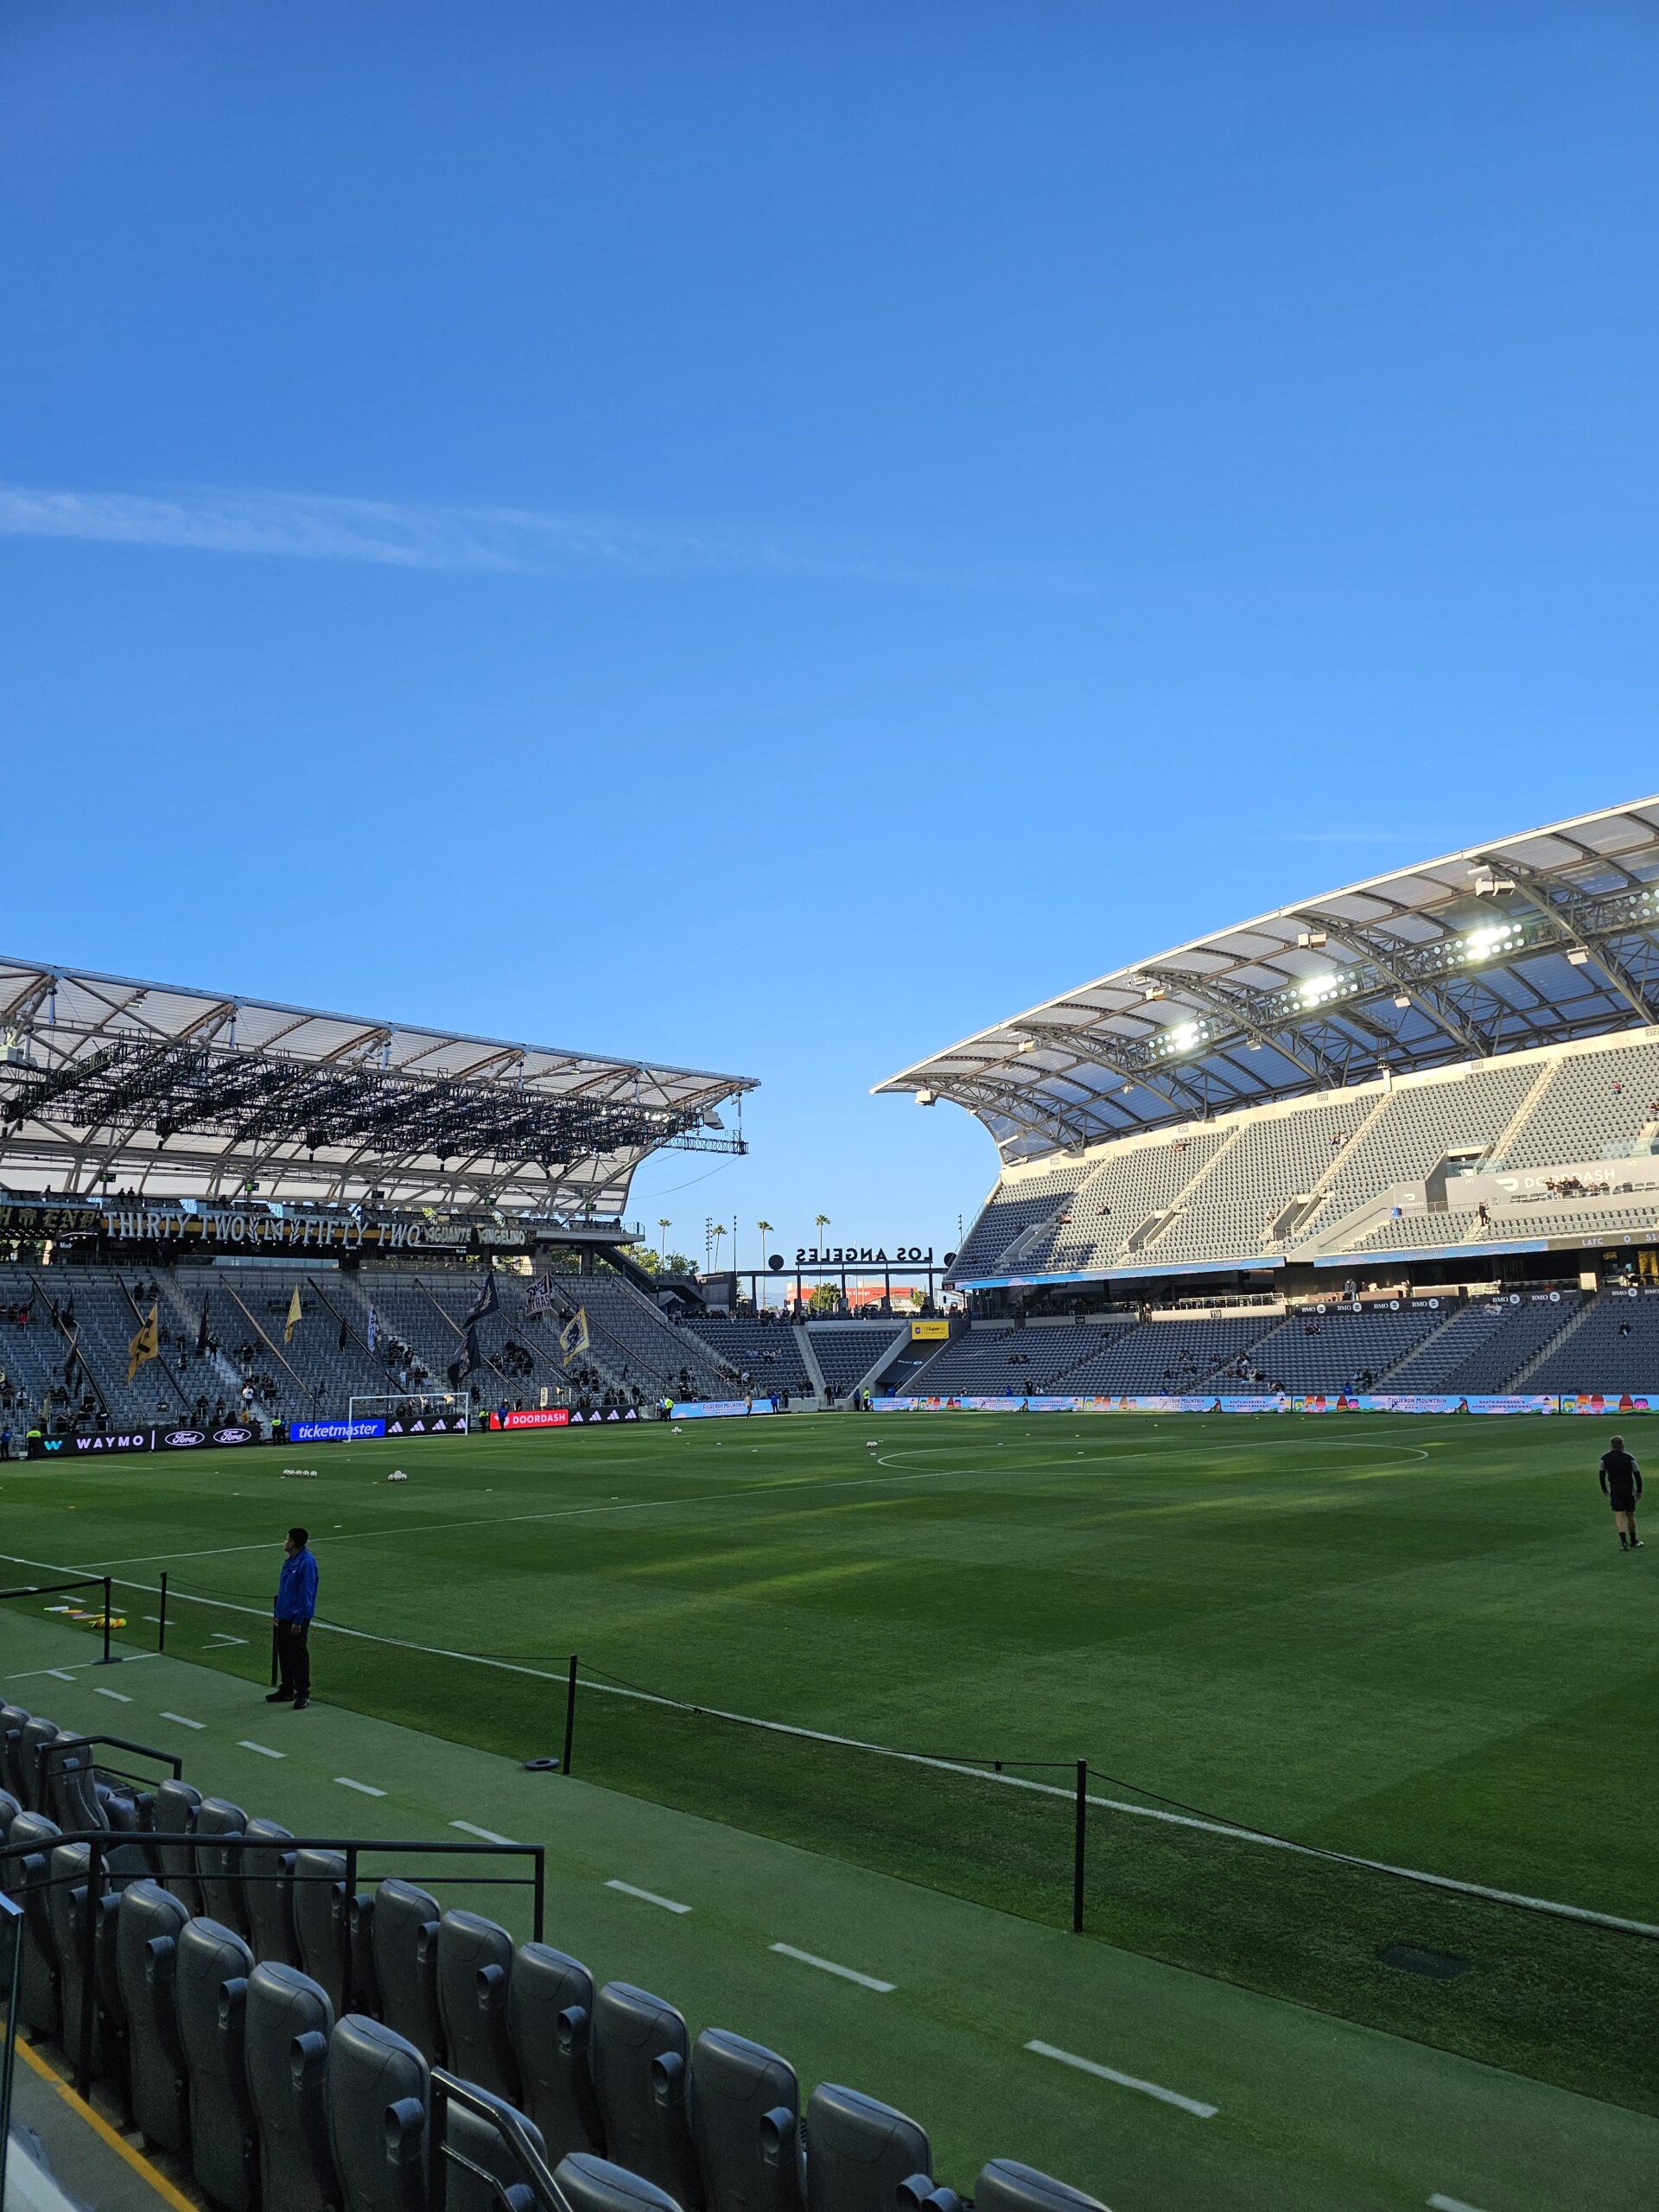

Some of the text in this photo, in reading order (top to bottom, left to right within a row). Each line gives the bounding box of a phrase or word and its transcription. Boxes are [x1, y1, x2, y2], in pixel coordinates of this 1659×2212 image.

[103, 1211, 192, 1238] THIRTY
[198, 1214, 245, 1242] TWO
[302, 1219, 369, 1245] FIFTY
[377, 1223, 421, 1248] TWO
[1582, 1237, 1604, 1246] LAFC
[512, 1413, 565, 1424] DOORDASH
[77, 1435, 144, 1450] WAYMO
[172, 1431, 197, 1444] Ford
[219, 1428, 245, 1441] Ford
[298, 1422, 378, 1439] ticketmaster
